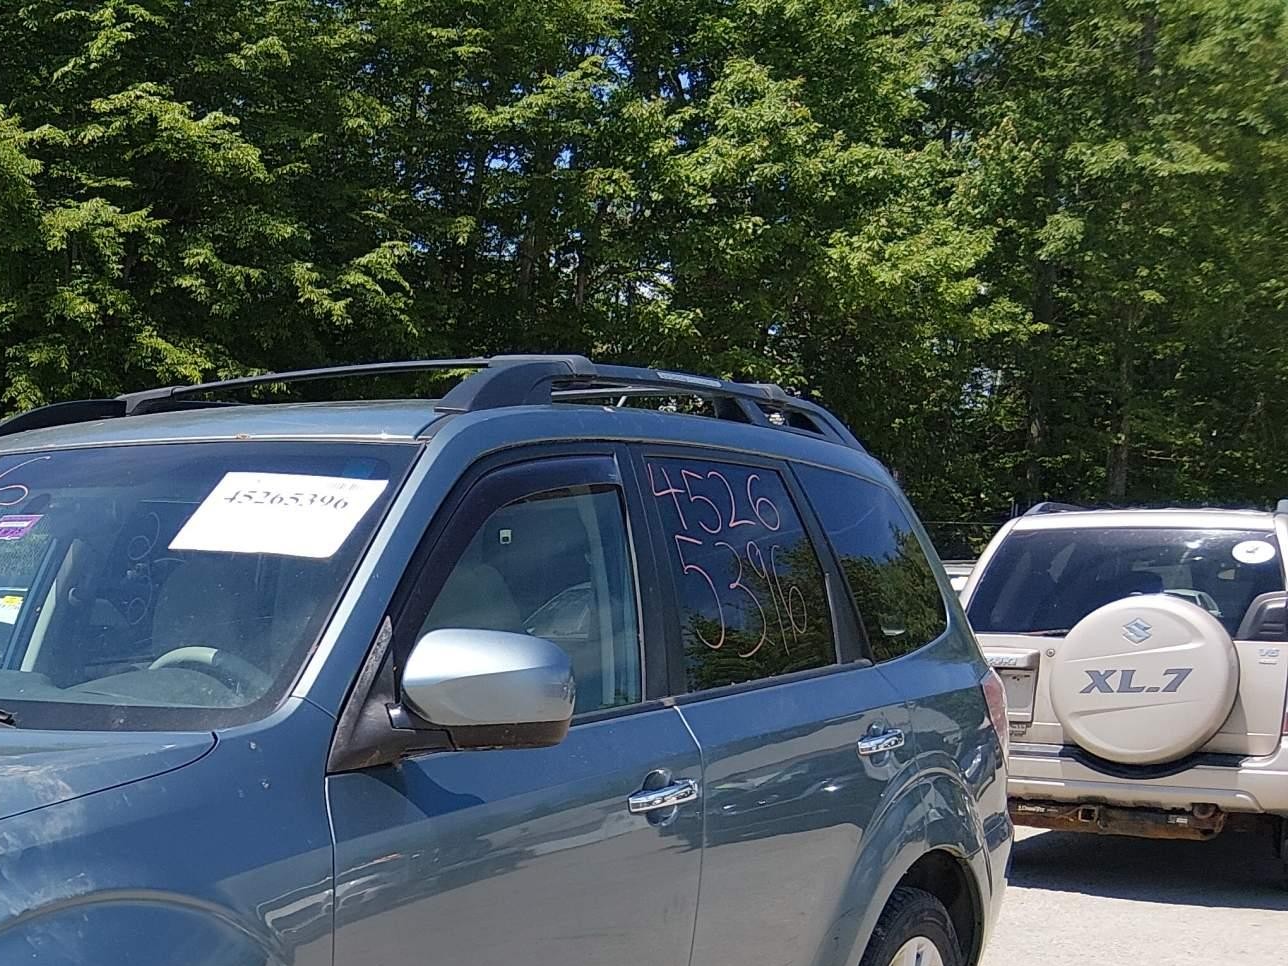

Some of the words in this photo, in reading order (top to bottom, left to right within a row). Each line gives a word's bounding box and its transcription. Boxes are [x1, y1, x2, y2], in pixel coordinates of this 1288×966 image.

[223, 489, 349, 511] 45265396
[647, 462, 781, 534] 4526
[674, 534, 808, 658] 5396
